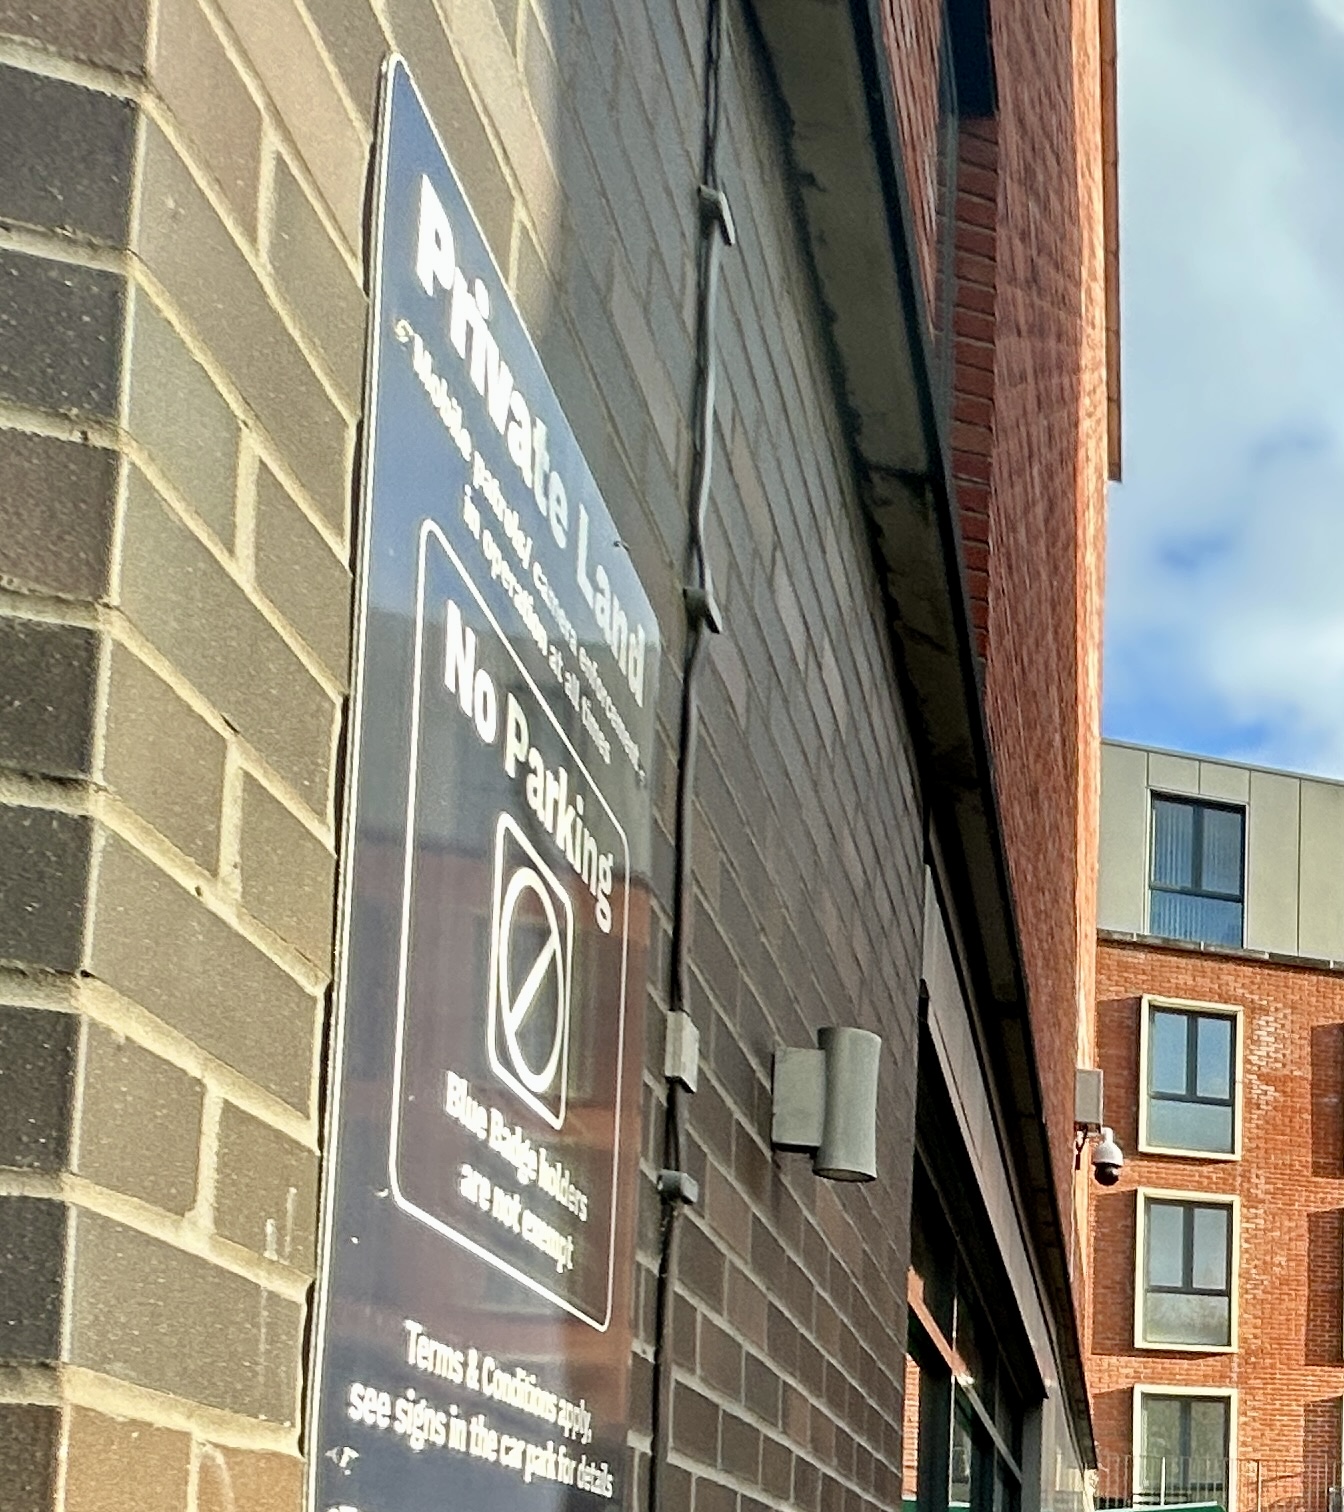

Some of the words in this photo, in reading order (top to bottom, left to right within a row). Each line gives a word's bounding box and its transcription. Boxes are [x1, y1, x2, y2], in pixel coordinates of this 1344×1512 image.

[416, 173, 569, 549] Private
[577, 503, 646, 708] Land
[463, 484, 481, 540] in
[482, 528, 548, 657] operation
[444, 599, 498, 744] No
[504, 691, 613, 934] Parking
[445, 1070, 488, 1140] Blue
[489, 1106, 538, 1186] Badge
[538, 1147, 588, 1223] holders
[459, 1163, 491, 1212] are
[492, 1185, 521, 1234] not
[521, 1208, 574, 1274] exempt
[348, 1382, 391, 1430] see
[393, 1387, 447, 1452] signs
[449, 1404, 467, 1452] in
[469, 1413, 499, 1462] the
[500, 1433, 526, 1469] car
[524, 1441, 557, 1484] park
[557, 1444, 577, 1486] for
[577, 1452, 613, 1499] details
[404, 1319, 464, 1384] Terms
[465, 1347, 480, 1392] &
[481, 1355, 557, 1424] Conditions
